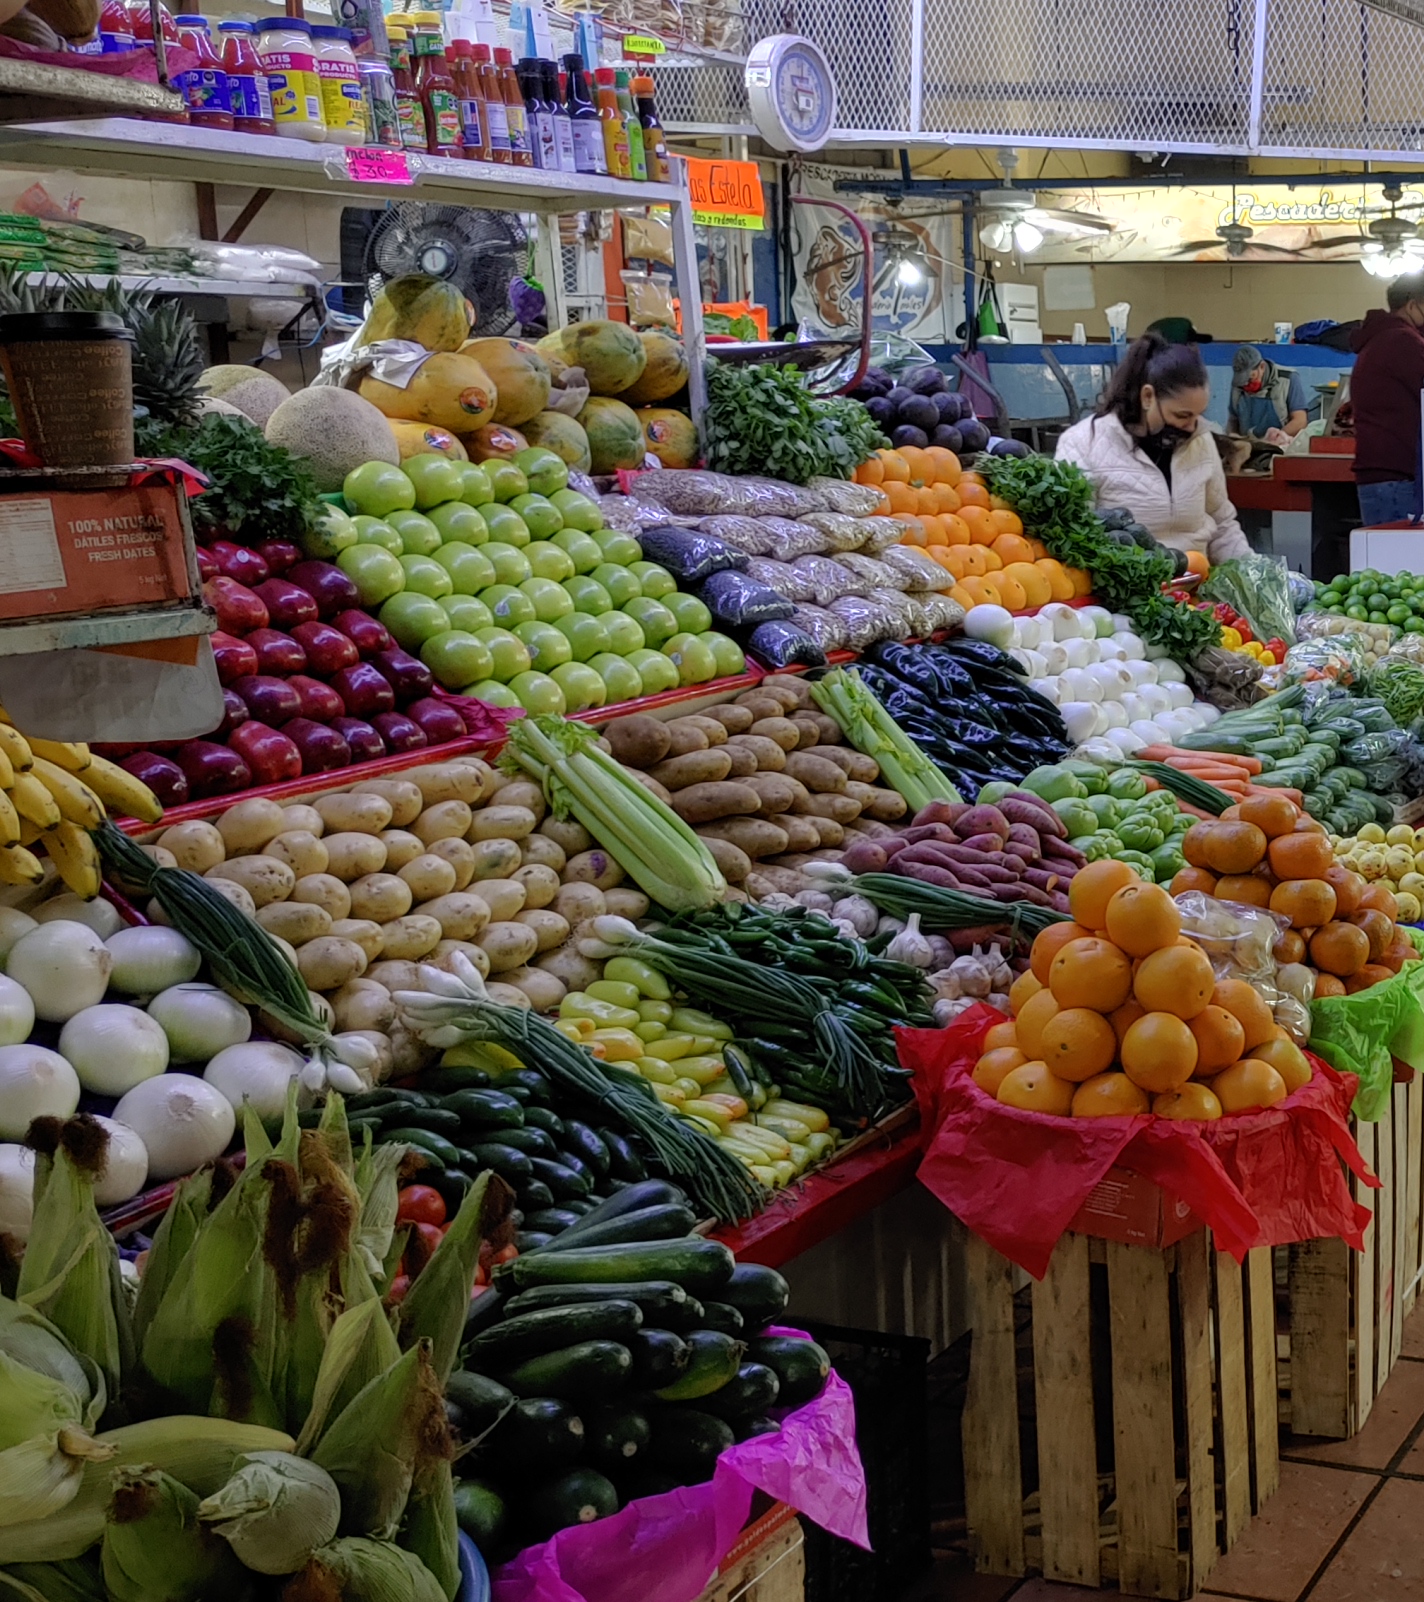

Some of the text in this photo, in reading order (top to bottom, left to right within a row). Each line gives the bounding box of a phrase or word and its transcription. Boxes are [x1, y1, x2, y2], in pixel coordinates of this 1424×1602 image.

[710, 165, 755, 209] Estela
[89, 388, 126, 398] Coffee
[93, 429, 127, 439] Coffee
[67, 514, 165, 534] 100% NATURAL
[74, 531, 163, 549] DÁTILES FRESCOS
[89, 547, 156, 562] FRESH DATES
